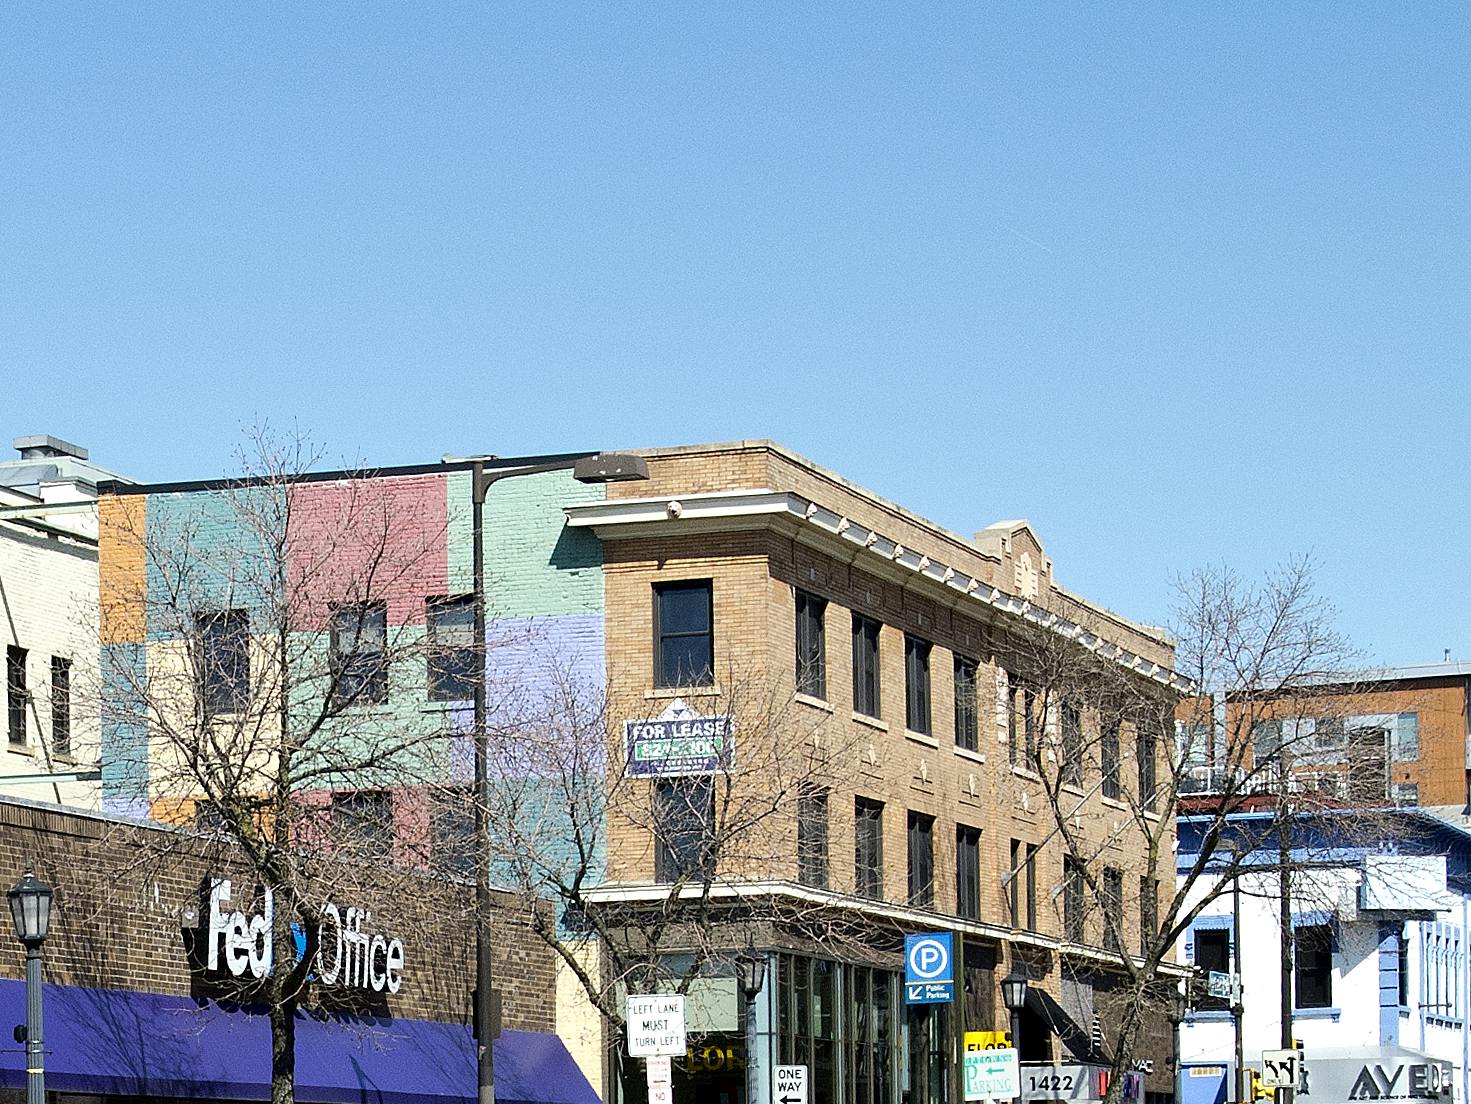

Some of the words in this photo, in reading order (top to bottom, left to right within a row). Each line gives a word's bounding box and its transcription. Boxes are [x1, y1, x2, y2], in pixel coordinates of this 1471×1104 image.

[632, 726, 666, 739] FOR
[672, 721, 726, 738] LEASE
[317, 903, 405, 994] Office
[633, 1005, 653, 1014] LEFT
[658, 1004, 679, 1013] LANE
[642, 1020, 668, 1031] MUST
[635, 1037, 656, 1047] TURN
[660, 1036, 679, 1045] LEFT
[778, 1069, 802, 1079] ONE
[778, 1081, 802, 1092] WAY
[1030, 1076, 1073, 1092] 1422
